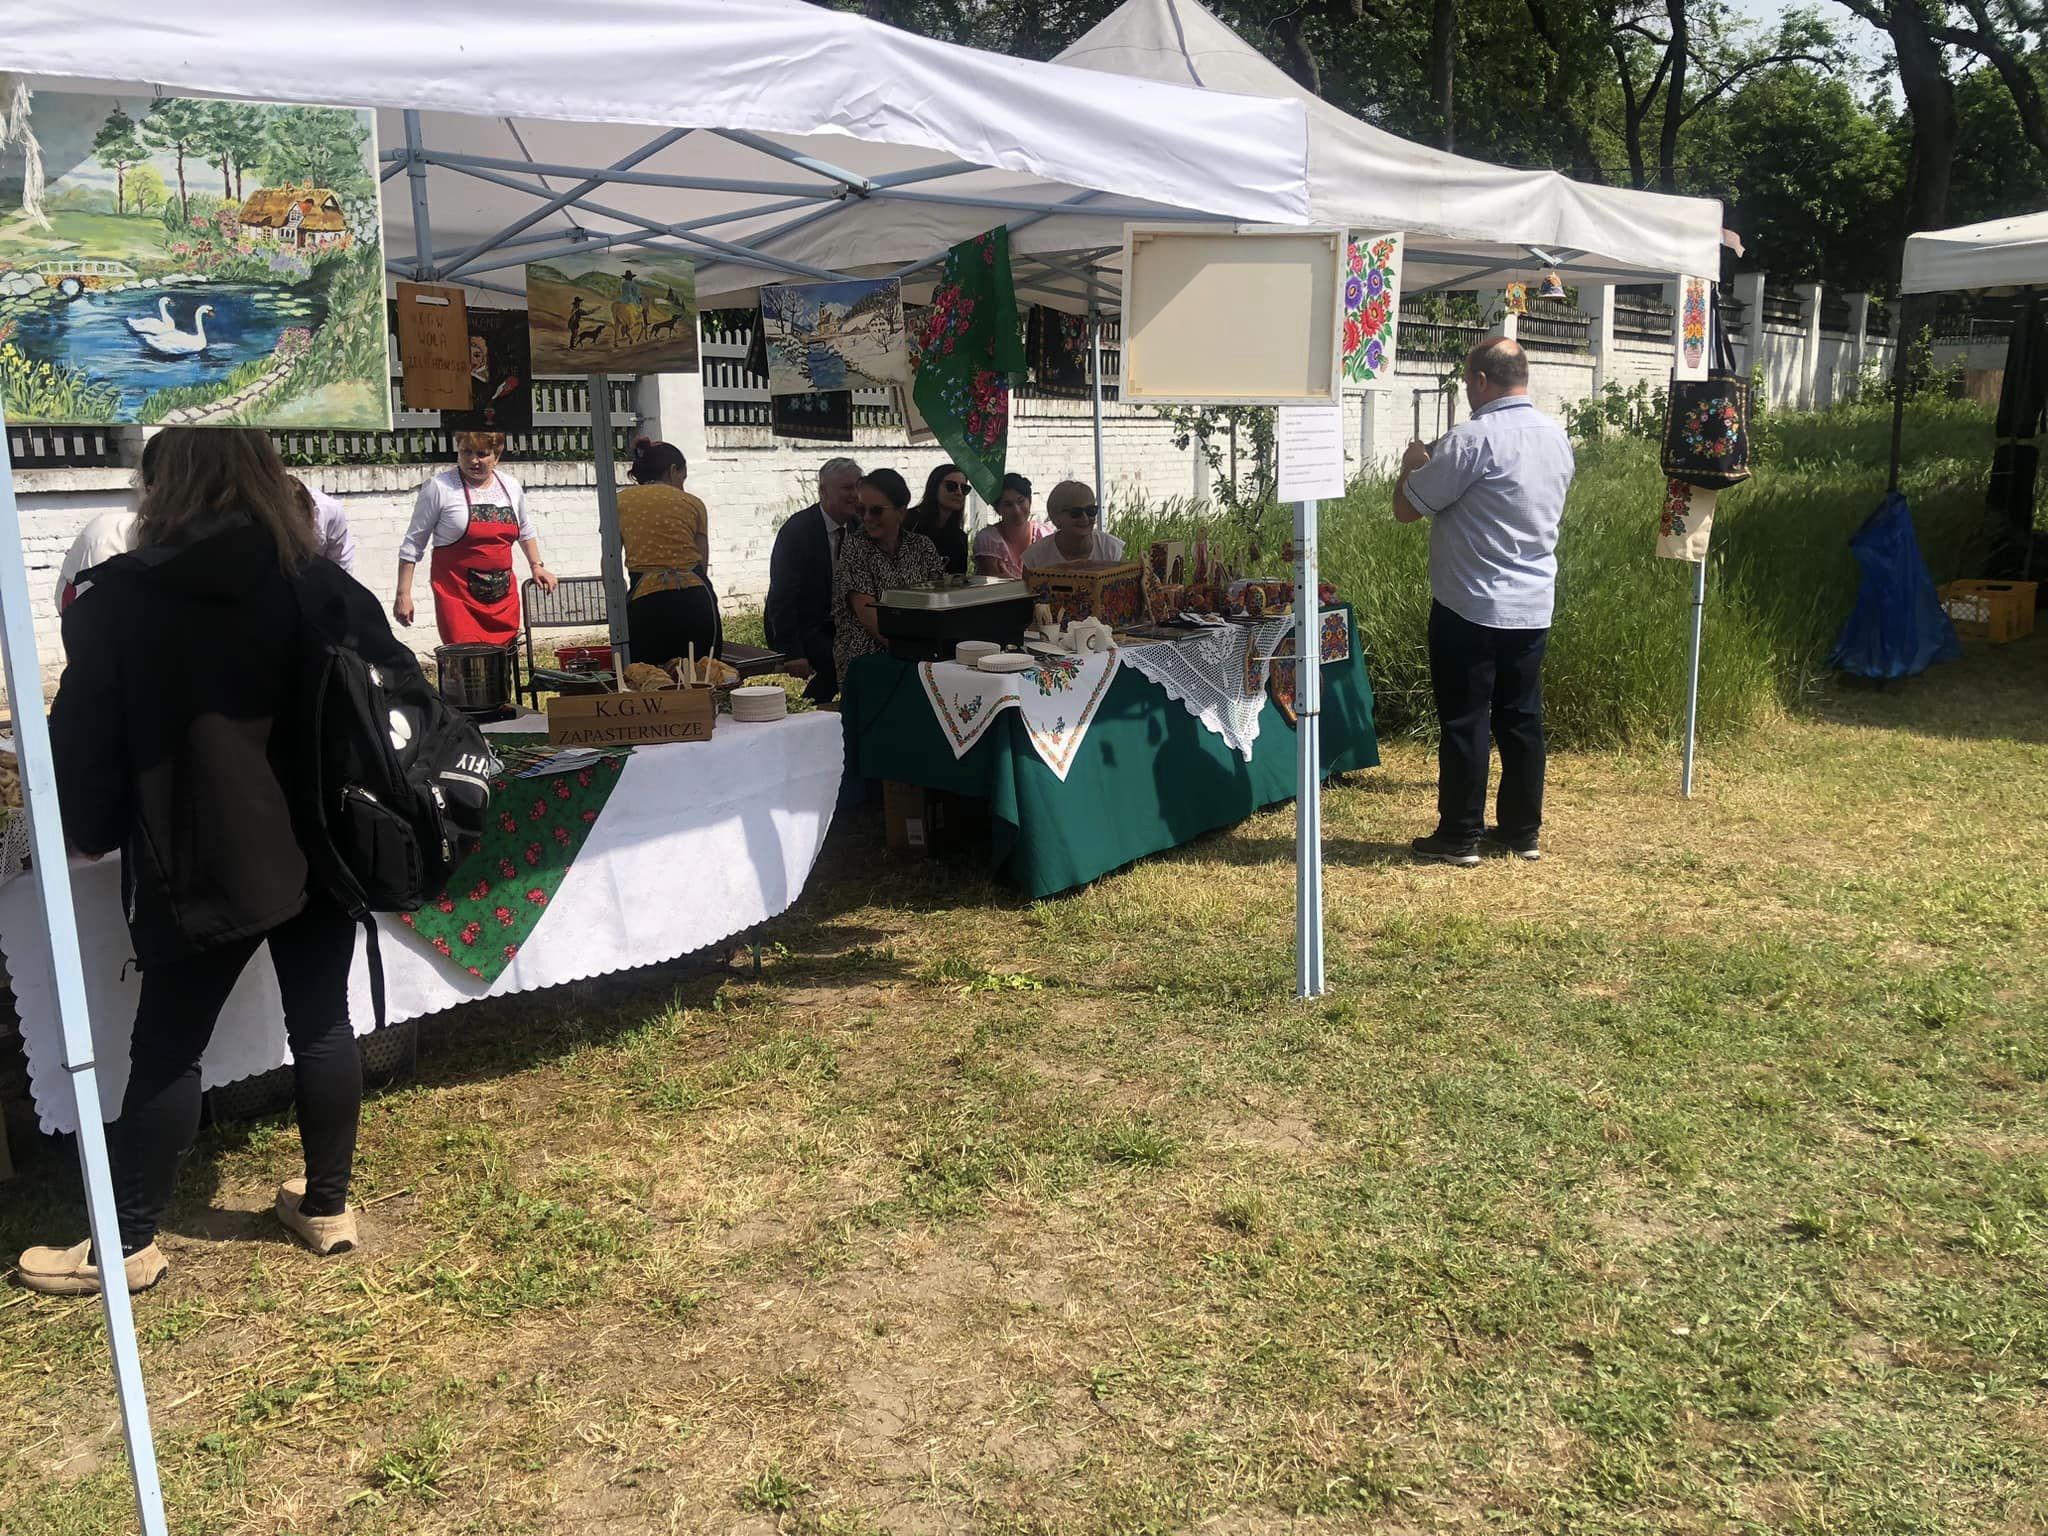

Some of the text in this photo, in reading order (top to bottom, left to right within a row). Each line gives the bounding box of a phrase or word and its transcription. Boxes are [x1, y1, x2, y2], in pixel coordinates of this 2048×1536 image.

[418, 331, 448, 348] WOLA
[596, 697, 668, 718] K.G.W.
[559, 722, 703, 744] ZAPASTERNICZE
